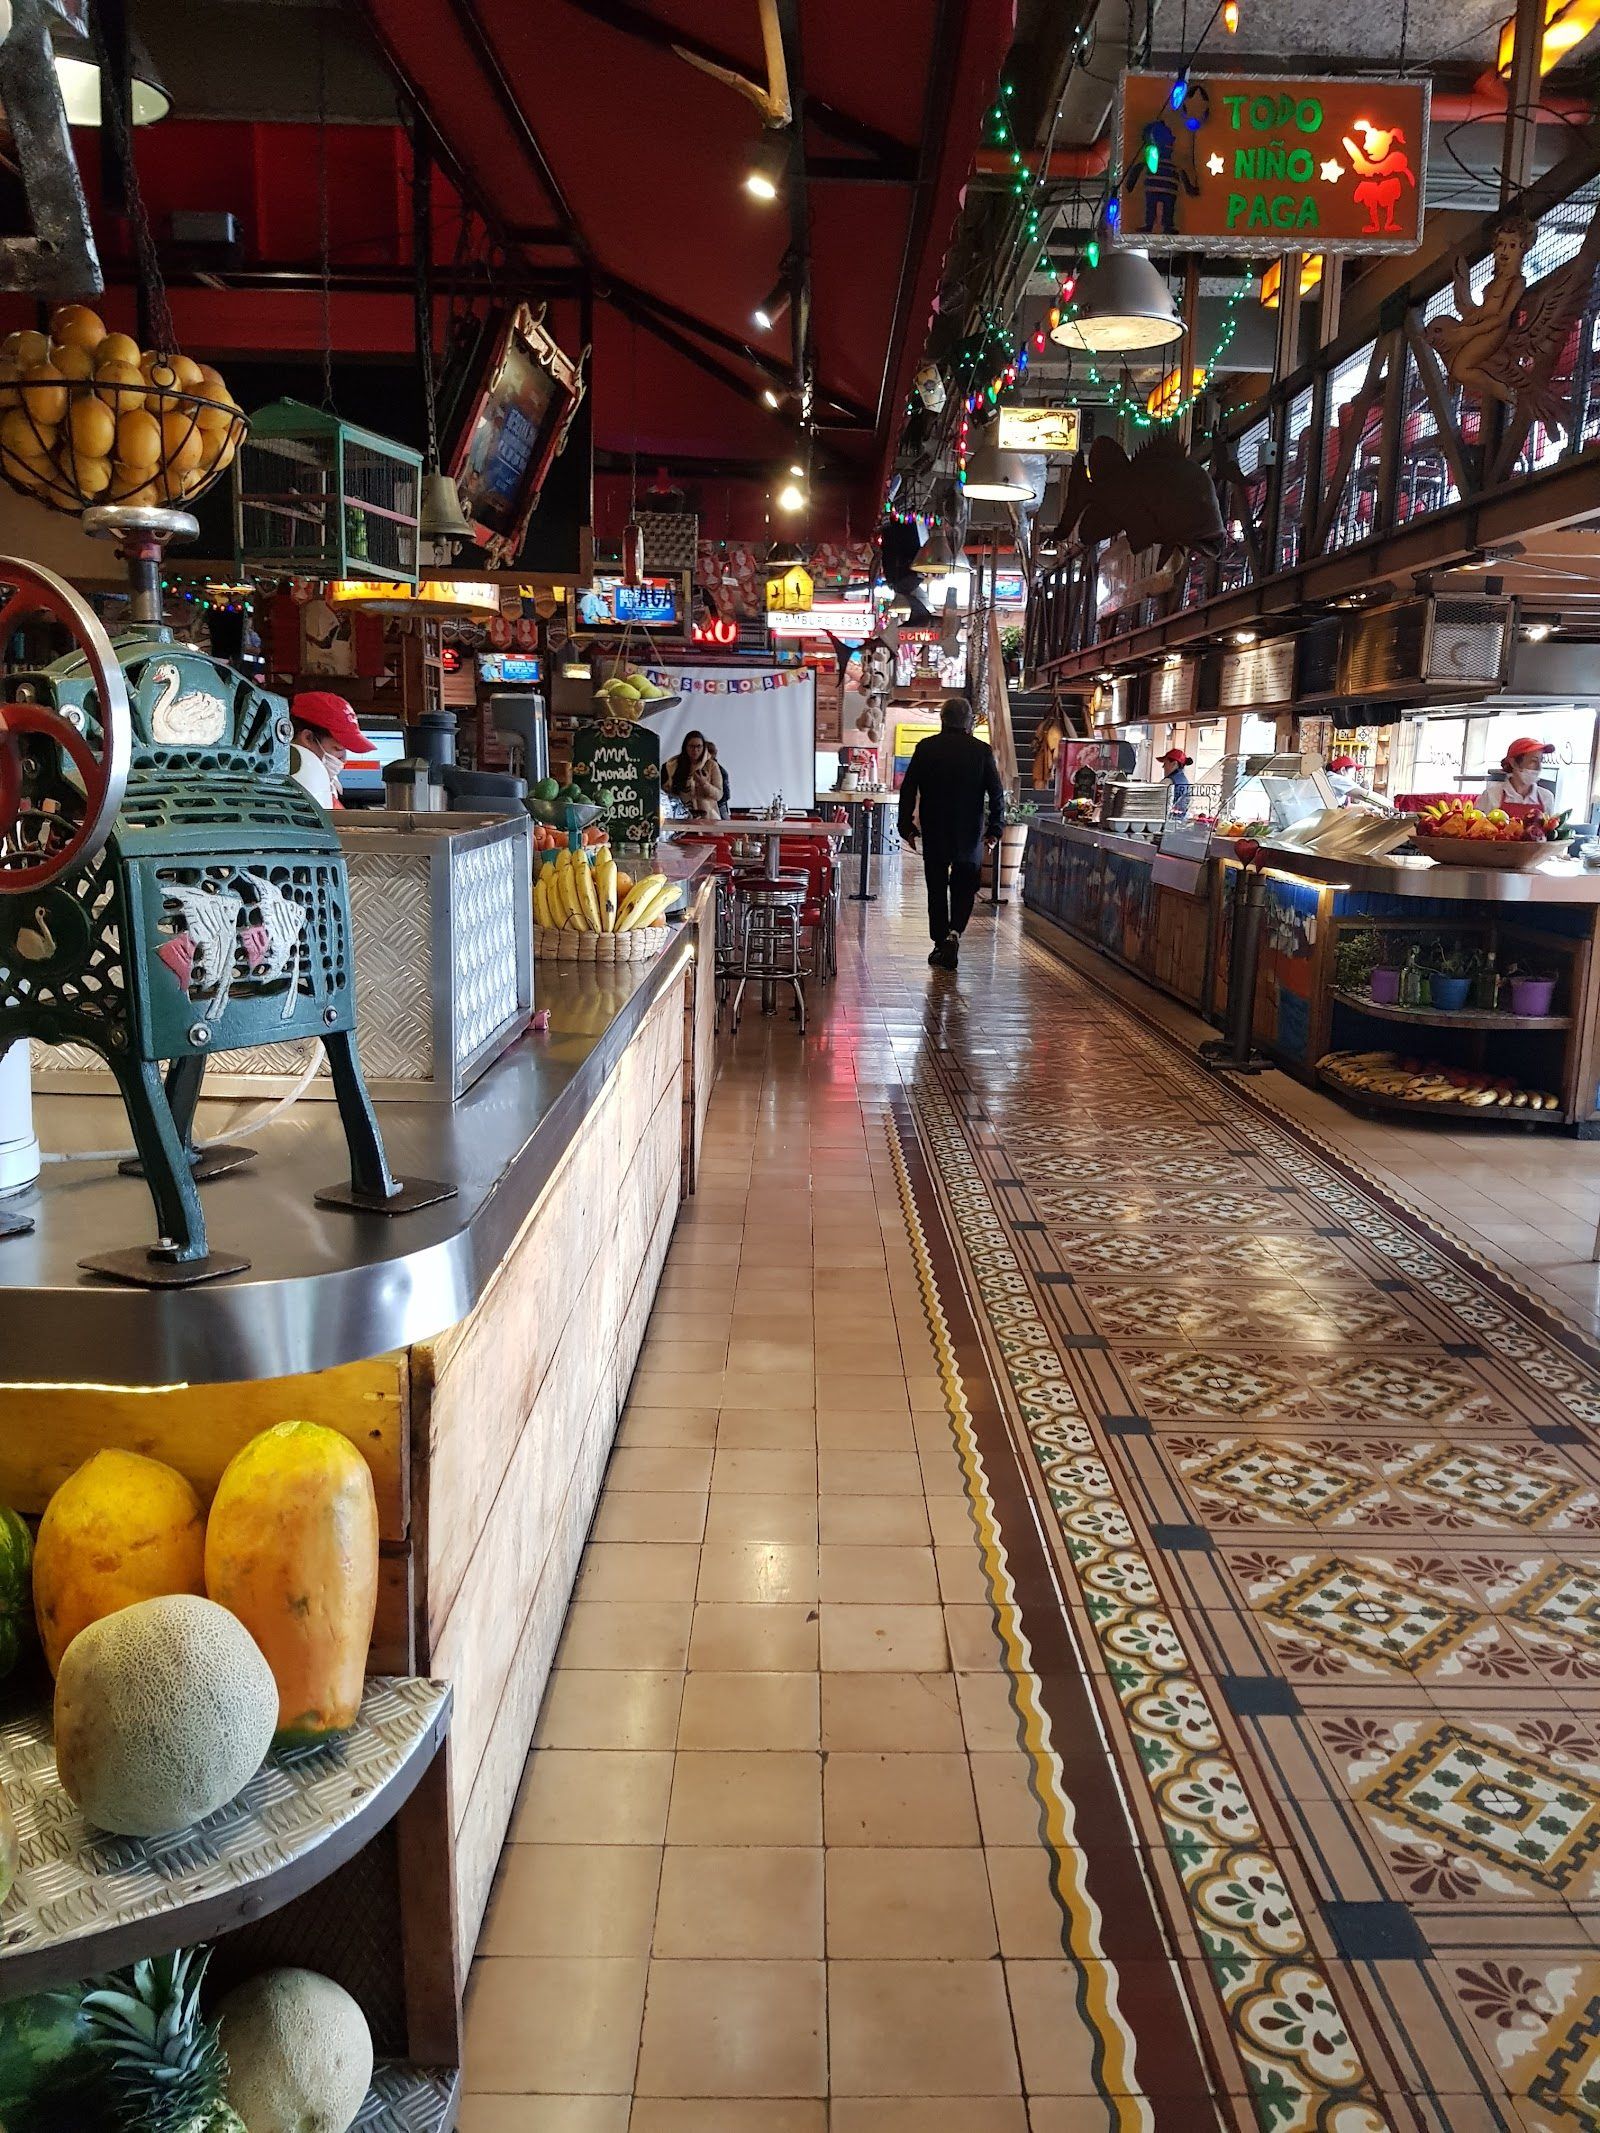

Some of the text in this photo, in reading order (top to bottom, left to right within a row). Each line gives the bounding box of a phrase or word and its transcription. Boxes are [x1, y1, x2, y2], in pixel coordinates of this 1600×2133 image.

[1222, 93, 1324, 134] TODO
[1234, 139, 1315, 183] NIÑO
[1226, 193, 1321, 229] PAGA
[775, 615, 868, 627] HAMBURGESAS
[705, 673, 797, 693] COLOMBIA
